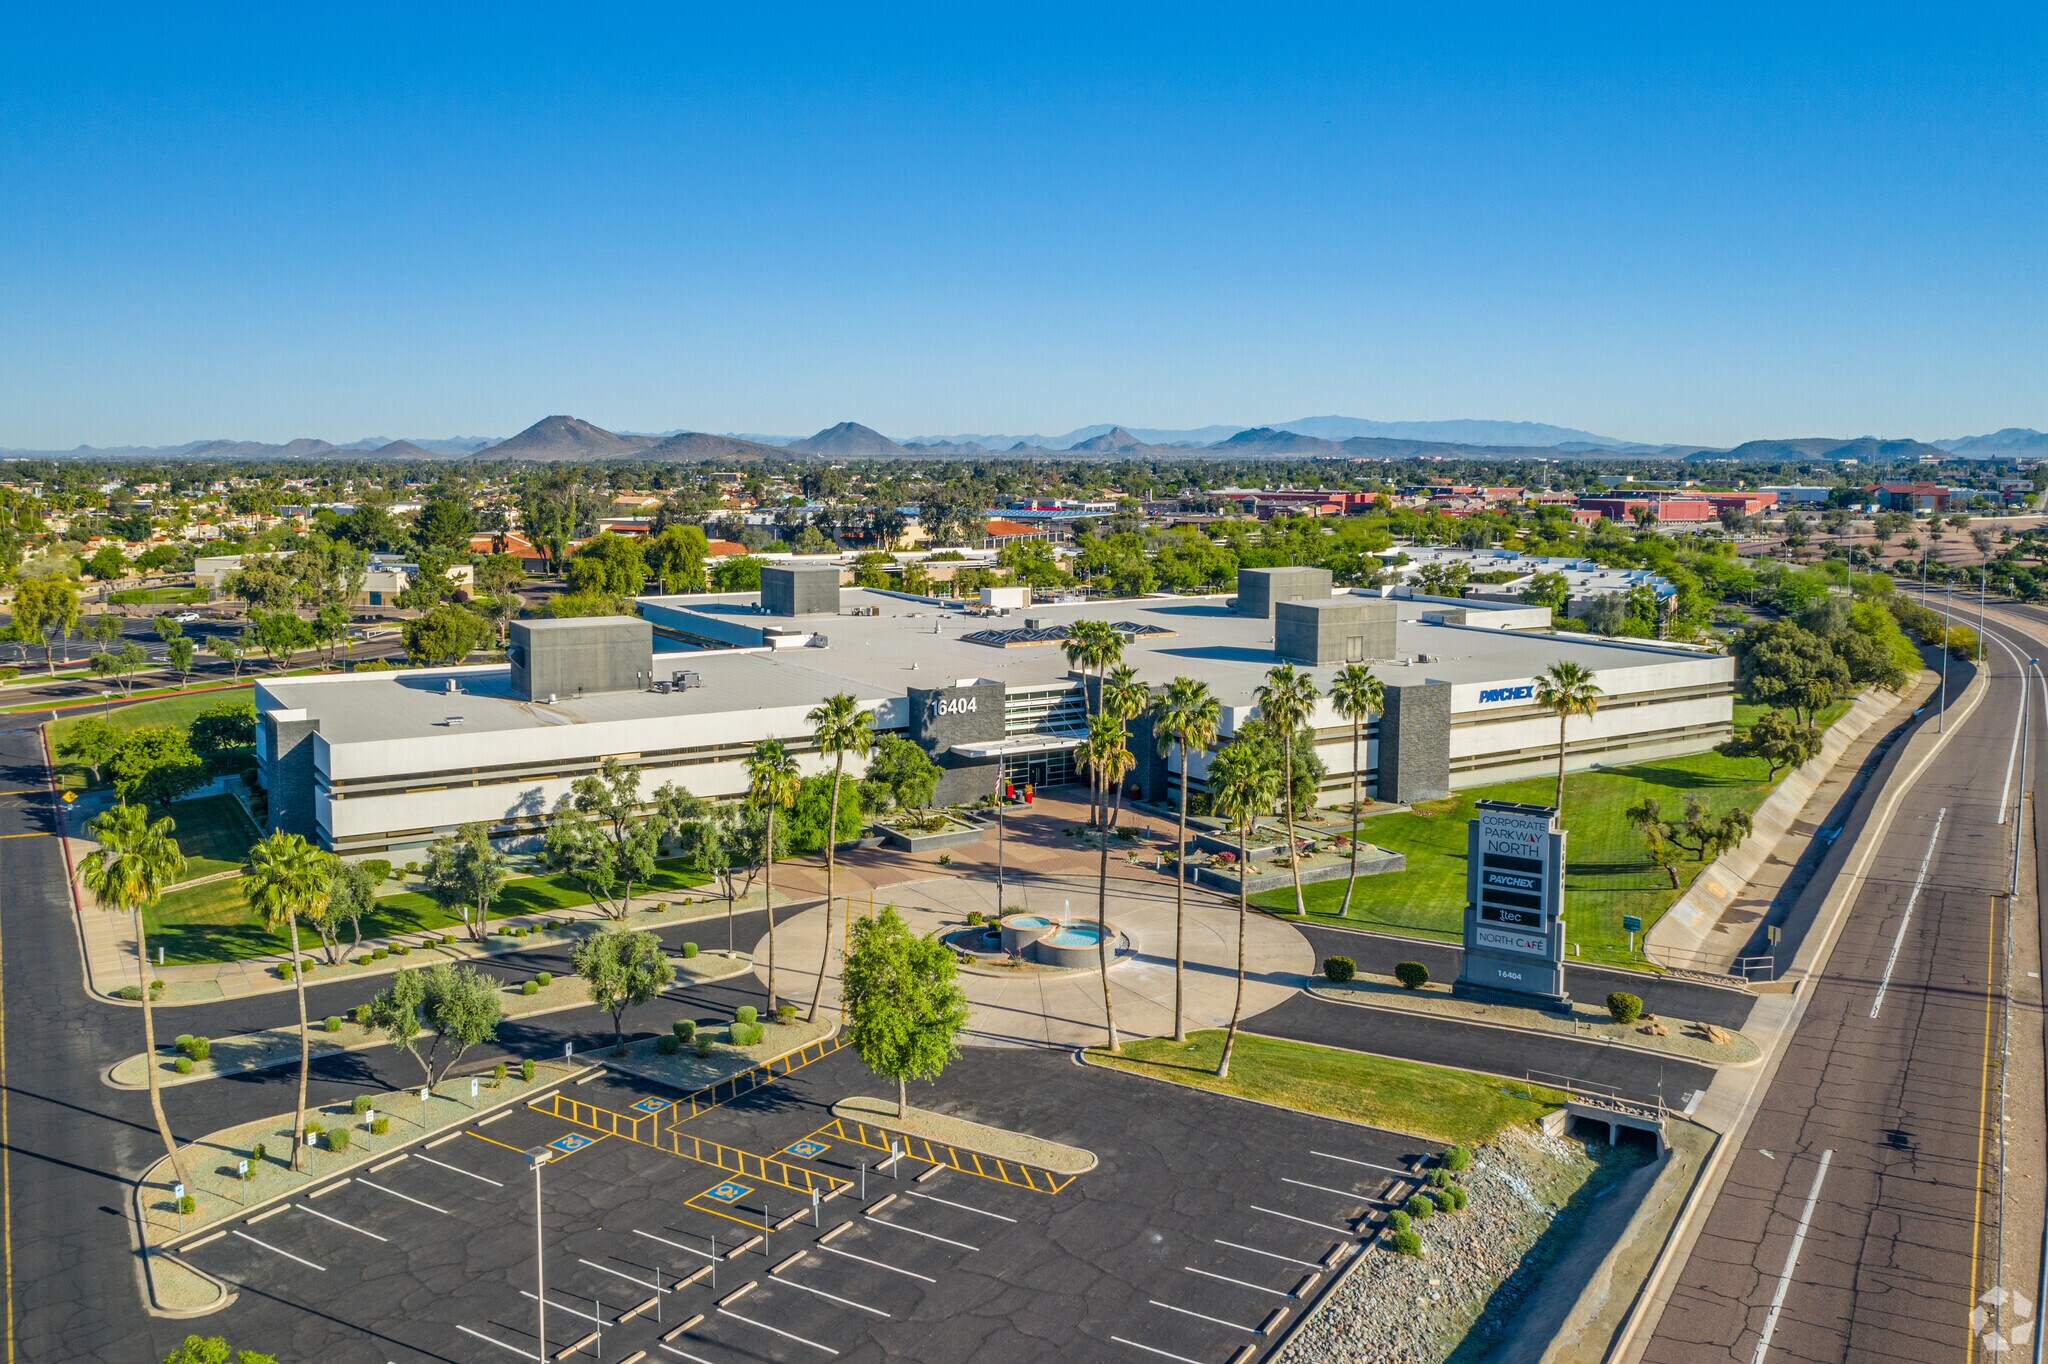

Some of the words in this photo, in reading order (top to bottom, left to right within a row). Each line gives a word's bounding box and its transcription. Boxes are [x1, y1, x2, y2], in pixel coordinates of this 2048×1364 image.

[1479, 685, 1534, 703] PAYCHEX
[931, 696, 977, 716] 16404
[1482, 815, 1546, 832] CORPORATE
[1485, 827, 1543, 843] PARKWAY
[1488, 839, 1539, 857] NORTH
[1489, 874, 1534, 888] PAYCHEX
[1499, 909, 1522, 922] ttec
[1479, 932, 1514, 946] NORTH
[1515, 938, 1544, 951] CAFÉ
[1497, 969, 1522, 981] 16404
